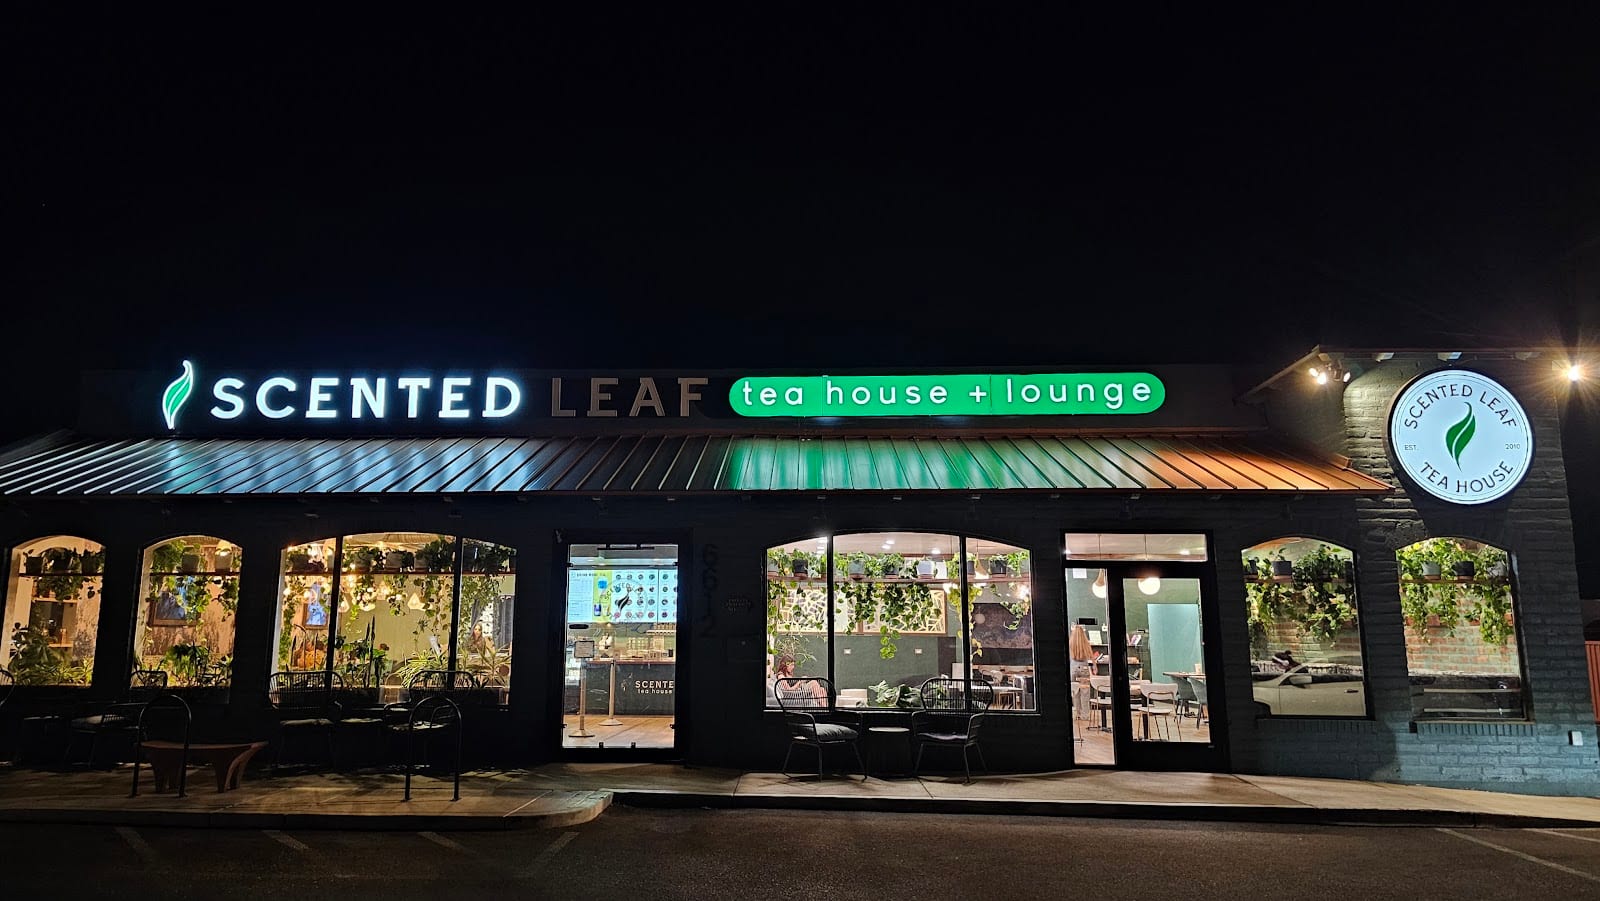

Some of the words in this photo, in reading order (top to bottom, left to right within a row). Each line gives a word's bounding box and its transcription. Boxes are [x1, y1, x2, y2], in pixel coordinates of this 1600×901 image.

[210, 377, 521, 418] SCENTED
[551, 377, 709, 417] LEAF
[742, 381, 803, 406] tea
[826, 380, 948, 405] house
[1006, 378, 1151, 410] lounge
[1404, 383, 1473, 429] SCENTED
[1479, 391, 1517, 428] LEAF
[1420, 461, 1449, 490] TEA
[1455, 460, 1514, 493] HOUSE
